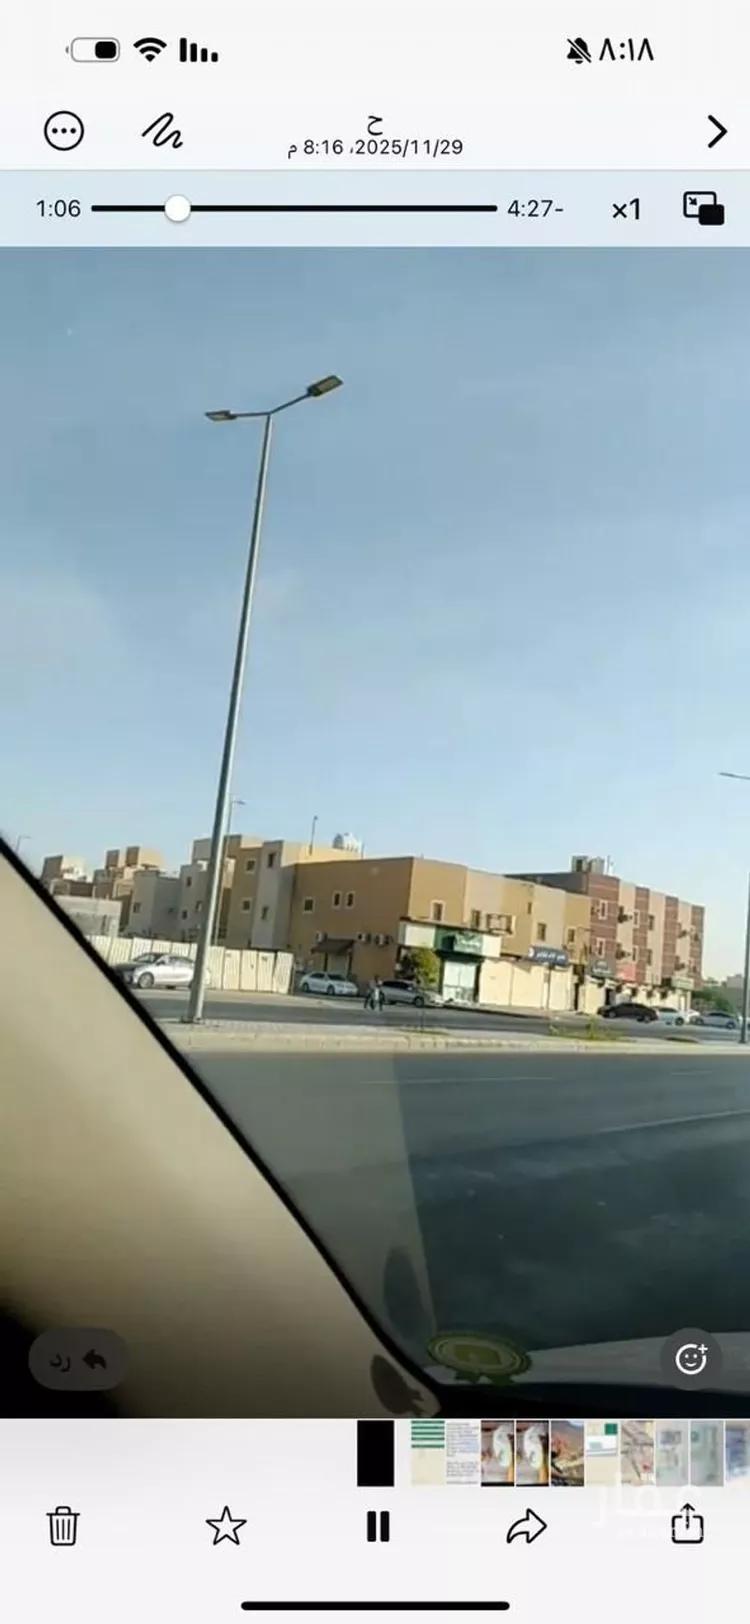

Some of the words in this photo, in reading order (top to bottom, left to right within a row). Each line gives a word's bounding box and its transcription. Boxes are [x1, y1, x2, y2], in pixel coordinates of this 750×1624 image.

[599, 37, 655, 62] ٨:١٨
[366, 115, 384, 137] ح
[287, 144, 298, 160] م
[303, 138, 344, 156] 8:16
[36, 199, 81, 218] 1:06
[48, 1352, 72, 1374] رد
